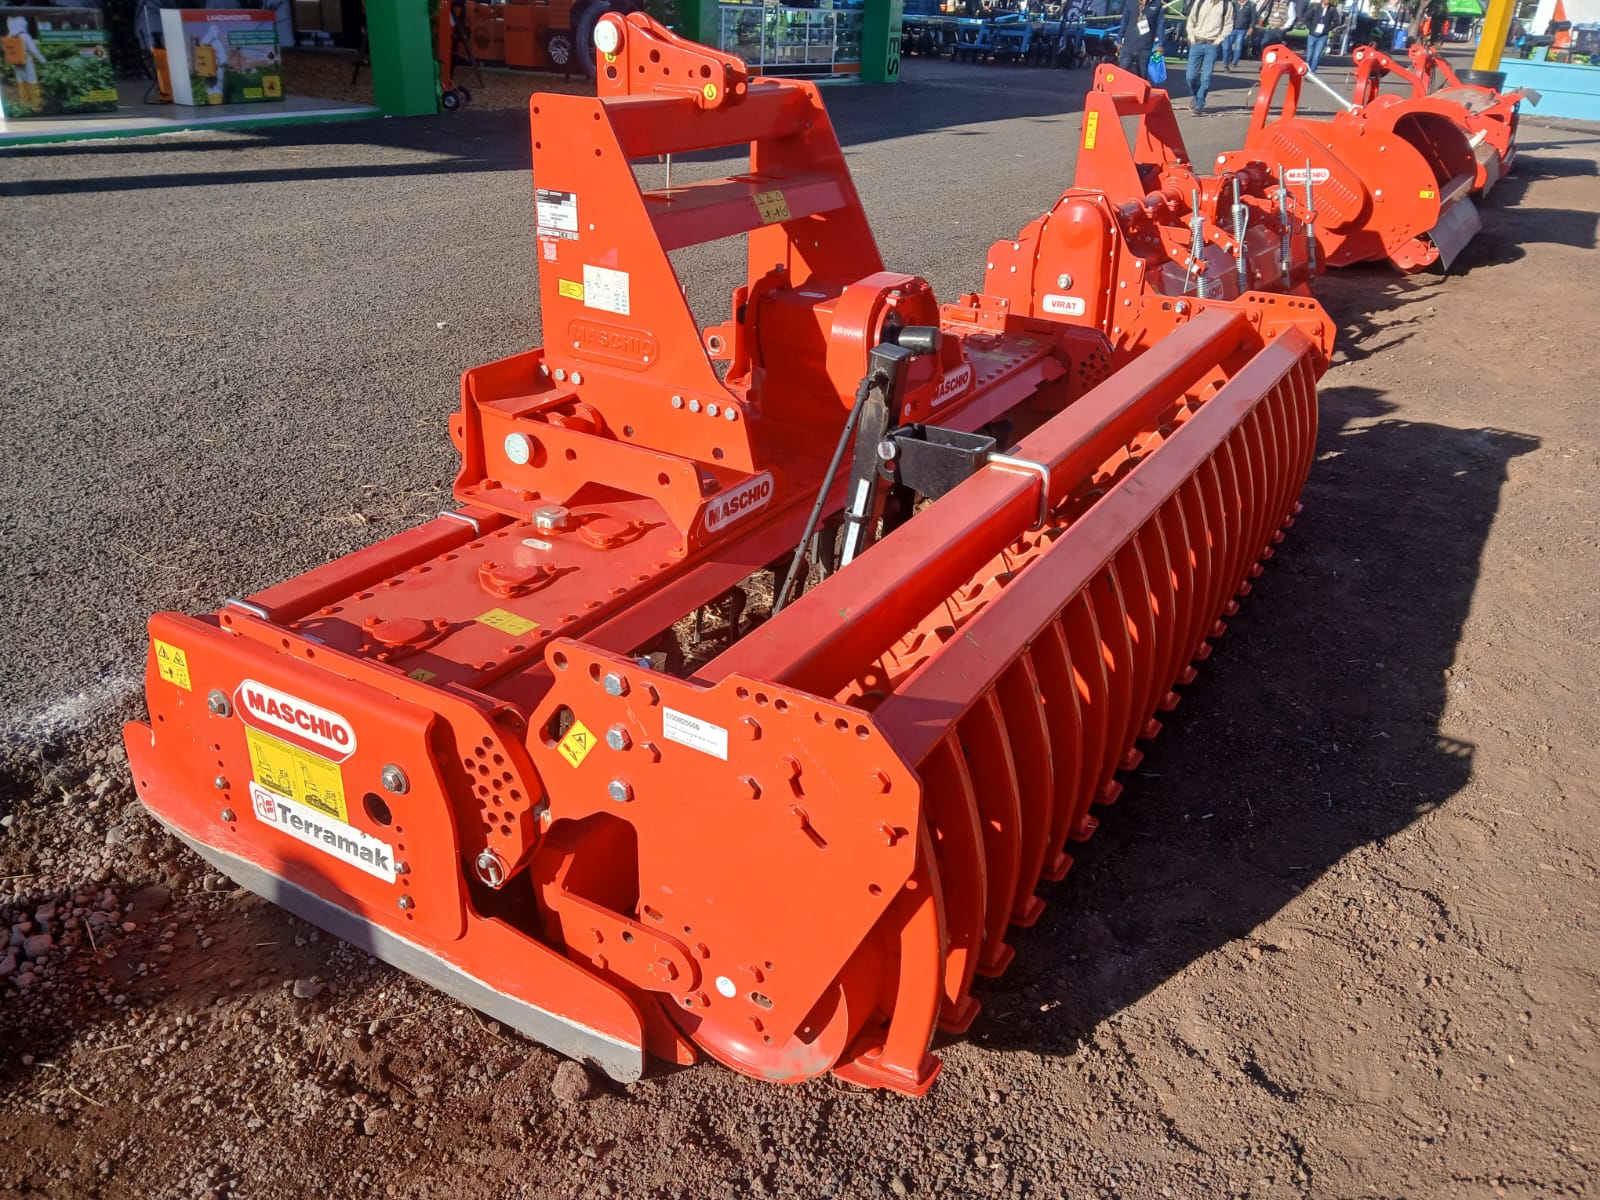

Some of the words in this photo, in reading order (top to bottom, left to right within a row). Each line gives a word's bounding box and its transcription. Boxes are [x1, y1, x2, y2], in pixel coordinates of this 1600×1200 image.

[1289, 171, 1327, 179] MASHIO
[1051, 299, 1077, 310] VIRAT
[571, 324, 654, 357] MASCHIO
[708, 480, 771, 528] MASCHIO
[246, 689, 349, 746] MASCHIO
[277, 802, 390, 872] Terramak
